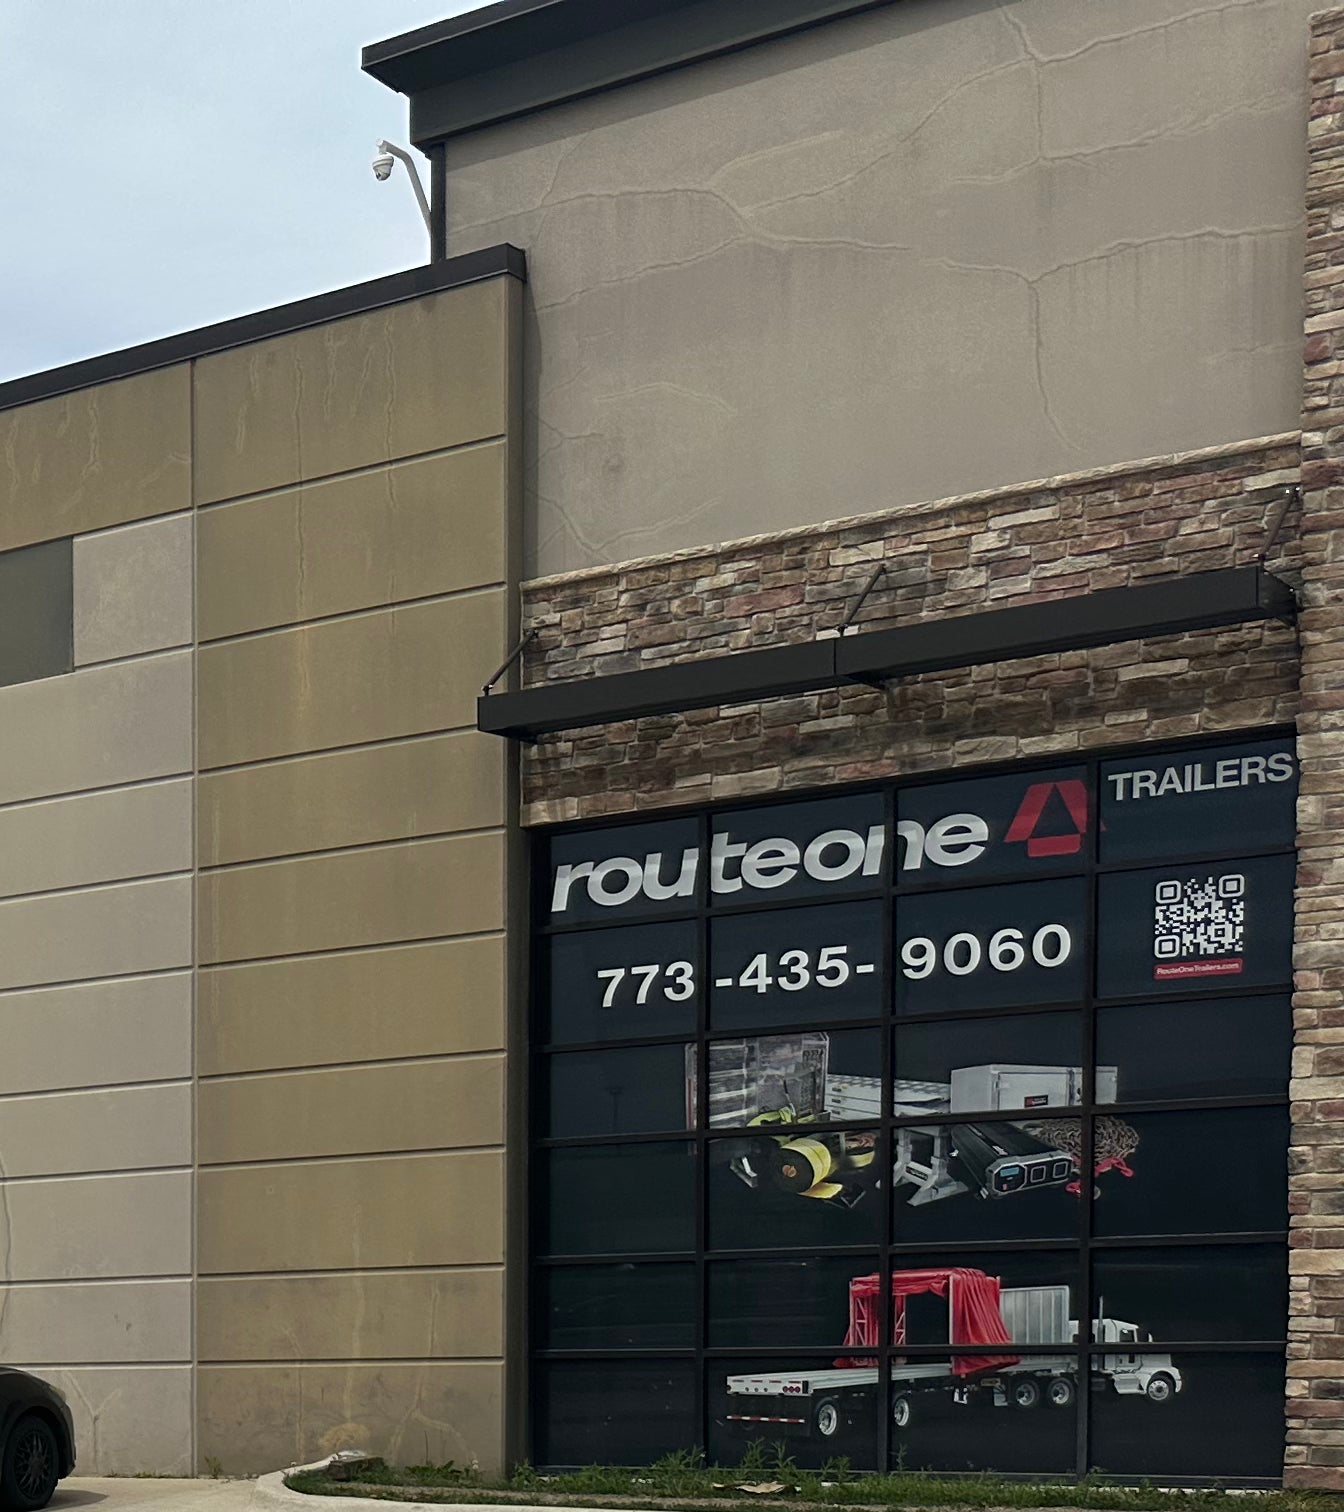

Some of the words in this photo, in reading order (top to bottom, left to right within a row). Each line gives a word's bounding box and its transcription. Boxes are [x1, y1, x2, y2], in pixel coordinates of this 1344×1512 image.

[1108, 752, 1294, 801] TRAILERS
[550, 812, 990, 913] routeone
[596, 960, 696, 1008] 773
[900, 923, 1072, 981] 9060
[1156, 962, 1240, 975] RouteOneTrailers.com
